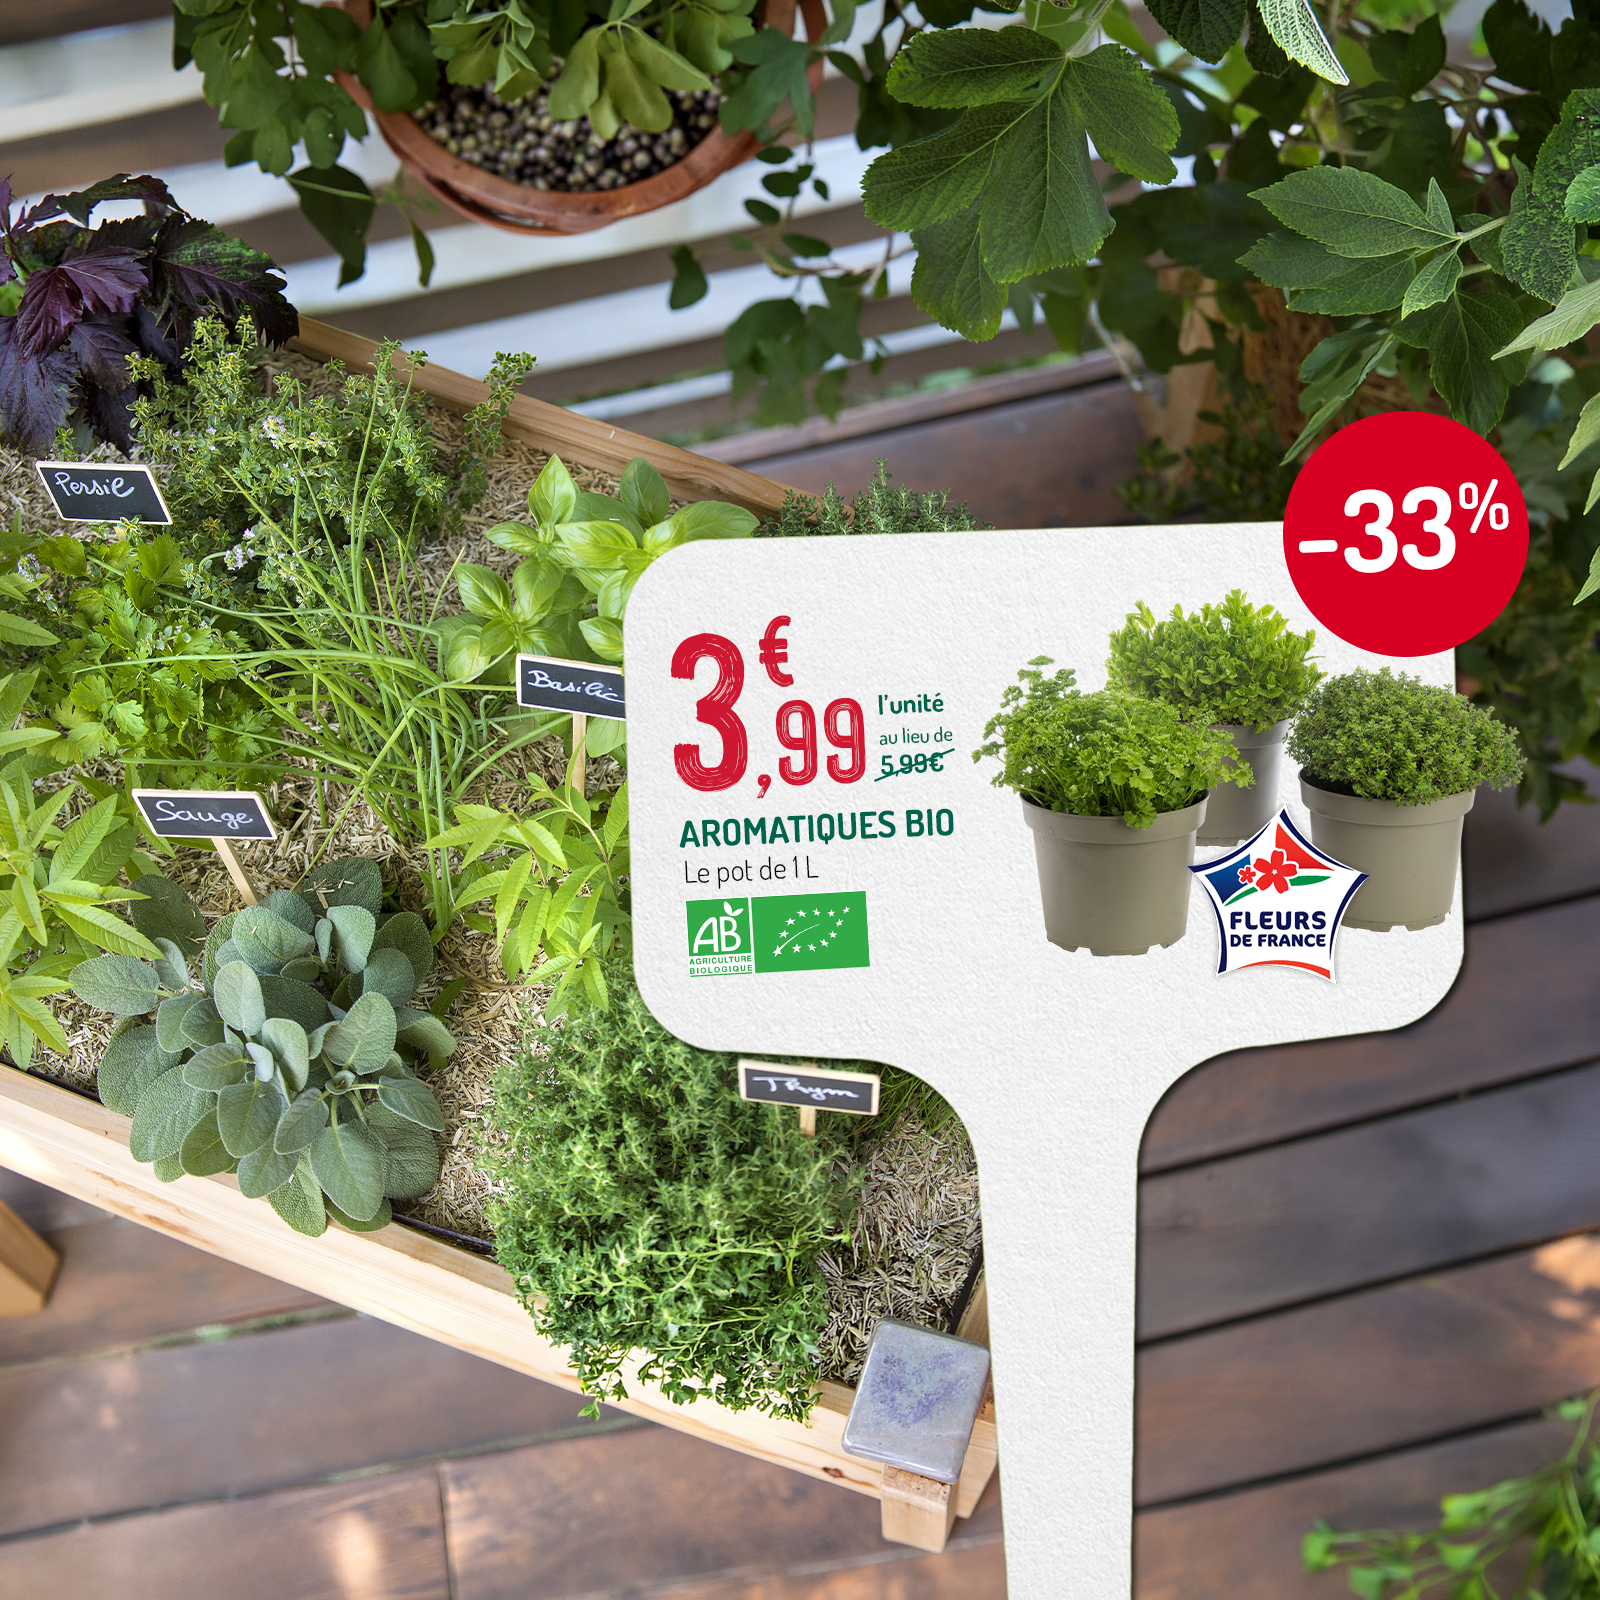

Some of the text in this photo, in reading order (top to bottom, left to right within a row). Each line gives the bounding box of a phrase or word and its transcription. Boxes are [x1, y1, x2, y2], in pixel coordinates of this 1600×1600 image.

[54, 471, 135, 498] Persil
[527, 669, 625, 704] Basilic
[878, 692, 944, 715] l'unité
[879, 726, 953, 746] au lieu de
[880, 751, 945, 778] 5,99€
[155, 800, 254, 830] Sauge
[679, 808, 955, 848] AROMATIQUES BIO
[684, 860, 710, 885] Le
[717, 859, 753, 889] pot
[759, 856, 787, 880] de
[1230, 911, 1327, 930] FLEURS
[693, 916, 741, 953] AB
[1230, 934, 1327, 947] DE FRANCE
[689, 955, 752, 966] AGRICULTURE
[689, 965, 753, 975] BIOLOGIQUE
[752, 1076, 860, 1101] Thym
